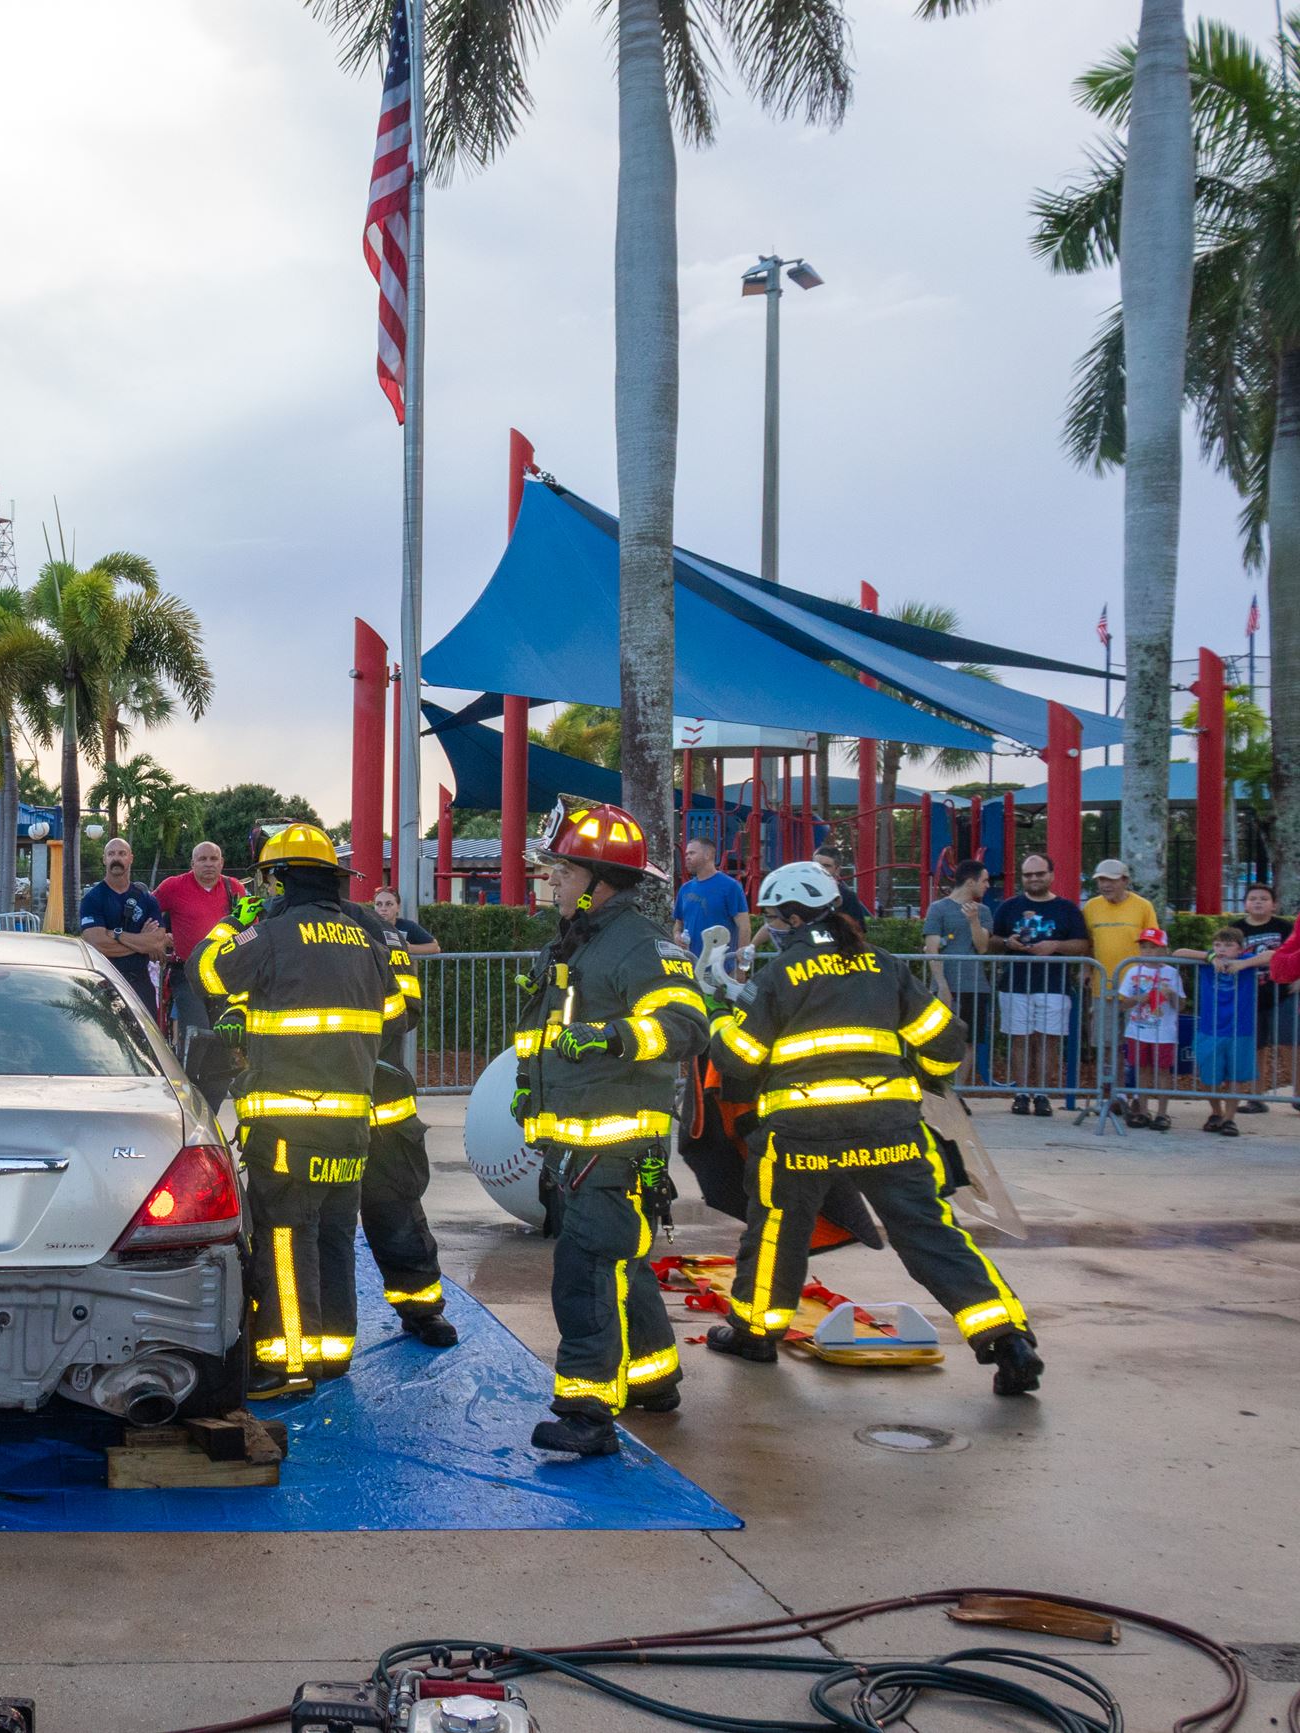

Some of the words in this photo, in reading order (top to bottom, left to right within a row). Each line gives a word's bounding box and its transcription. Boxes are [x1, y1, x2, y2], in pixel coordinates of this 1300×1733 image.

[299, 922, 370, 948] MARGATE
[661, 958, 694, 980] MFD
[785, 953, 881, 986] MARGATE
[112, 1146, 146, 1159] RL
[785, 1142, 921, 1171] LEON-JARJOURA
